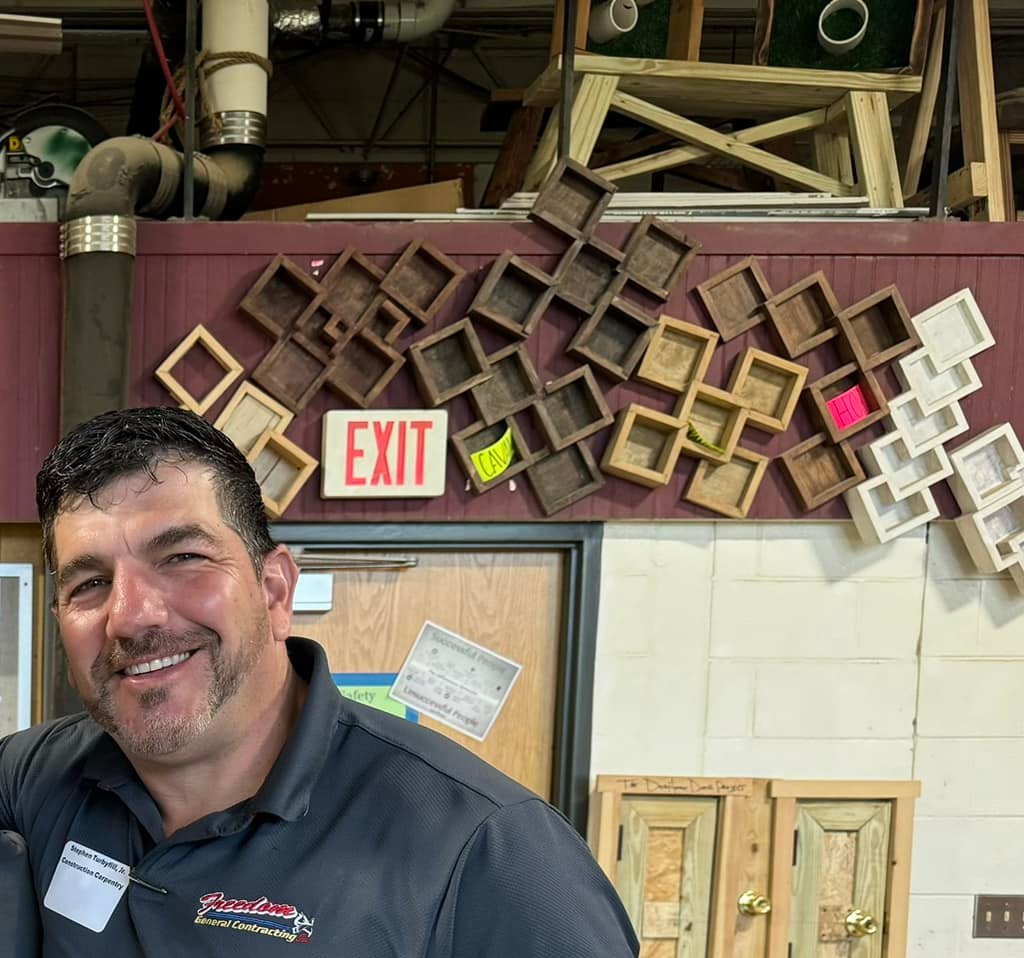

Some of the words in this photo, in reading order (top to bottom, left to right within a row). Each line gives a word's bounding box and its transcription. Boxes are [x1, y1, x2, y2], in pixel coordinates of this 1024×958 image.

[344, 420, 433, 487] EXIT
[61, 856, 94, 876] Construction
[94, 871, 125, 891] Carpentry
[197, 892, 298, 919] Freedom
[194, 915, 231, 929] General
[231, 920, 298, 943] Contracting
